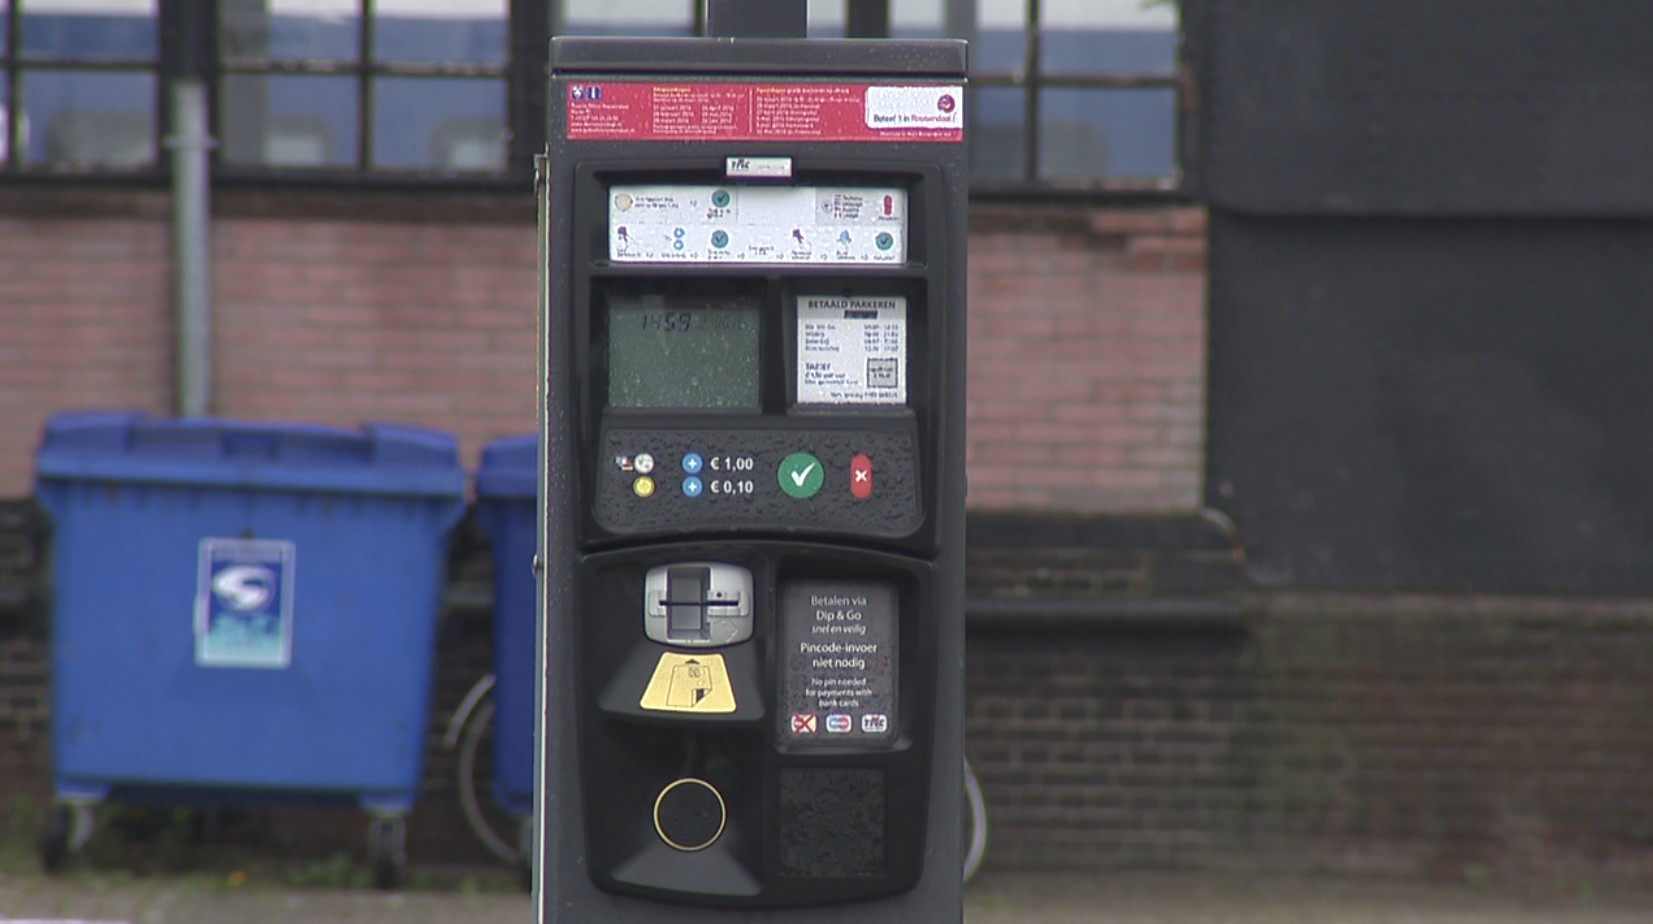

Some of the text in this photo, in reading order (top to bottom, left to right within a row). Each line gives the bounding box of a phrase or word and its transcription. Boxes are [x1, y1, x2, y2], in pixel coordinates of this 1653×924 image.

[808, 300, 896, 309] BETAALD PARKEREN
[710, 457, 754, 473] € 1,00
[710, 480, 754, 495] € 0,10
[810, 595, 867, 606] Betalen via
[816, 610, 862, 622] Dip & Go
[811, 624, 867, 635] snel en veilig
[800, 642, 878, 653] Pincode-invoer
[812, 658, 865, 670] niet nodig
[811, 678, 867, 687] No pin needed
[806, 688, 816, 696] for
[817, 689, 854, 698] payments
[818, 699, 859, 707] bank cards
